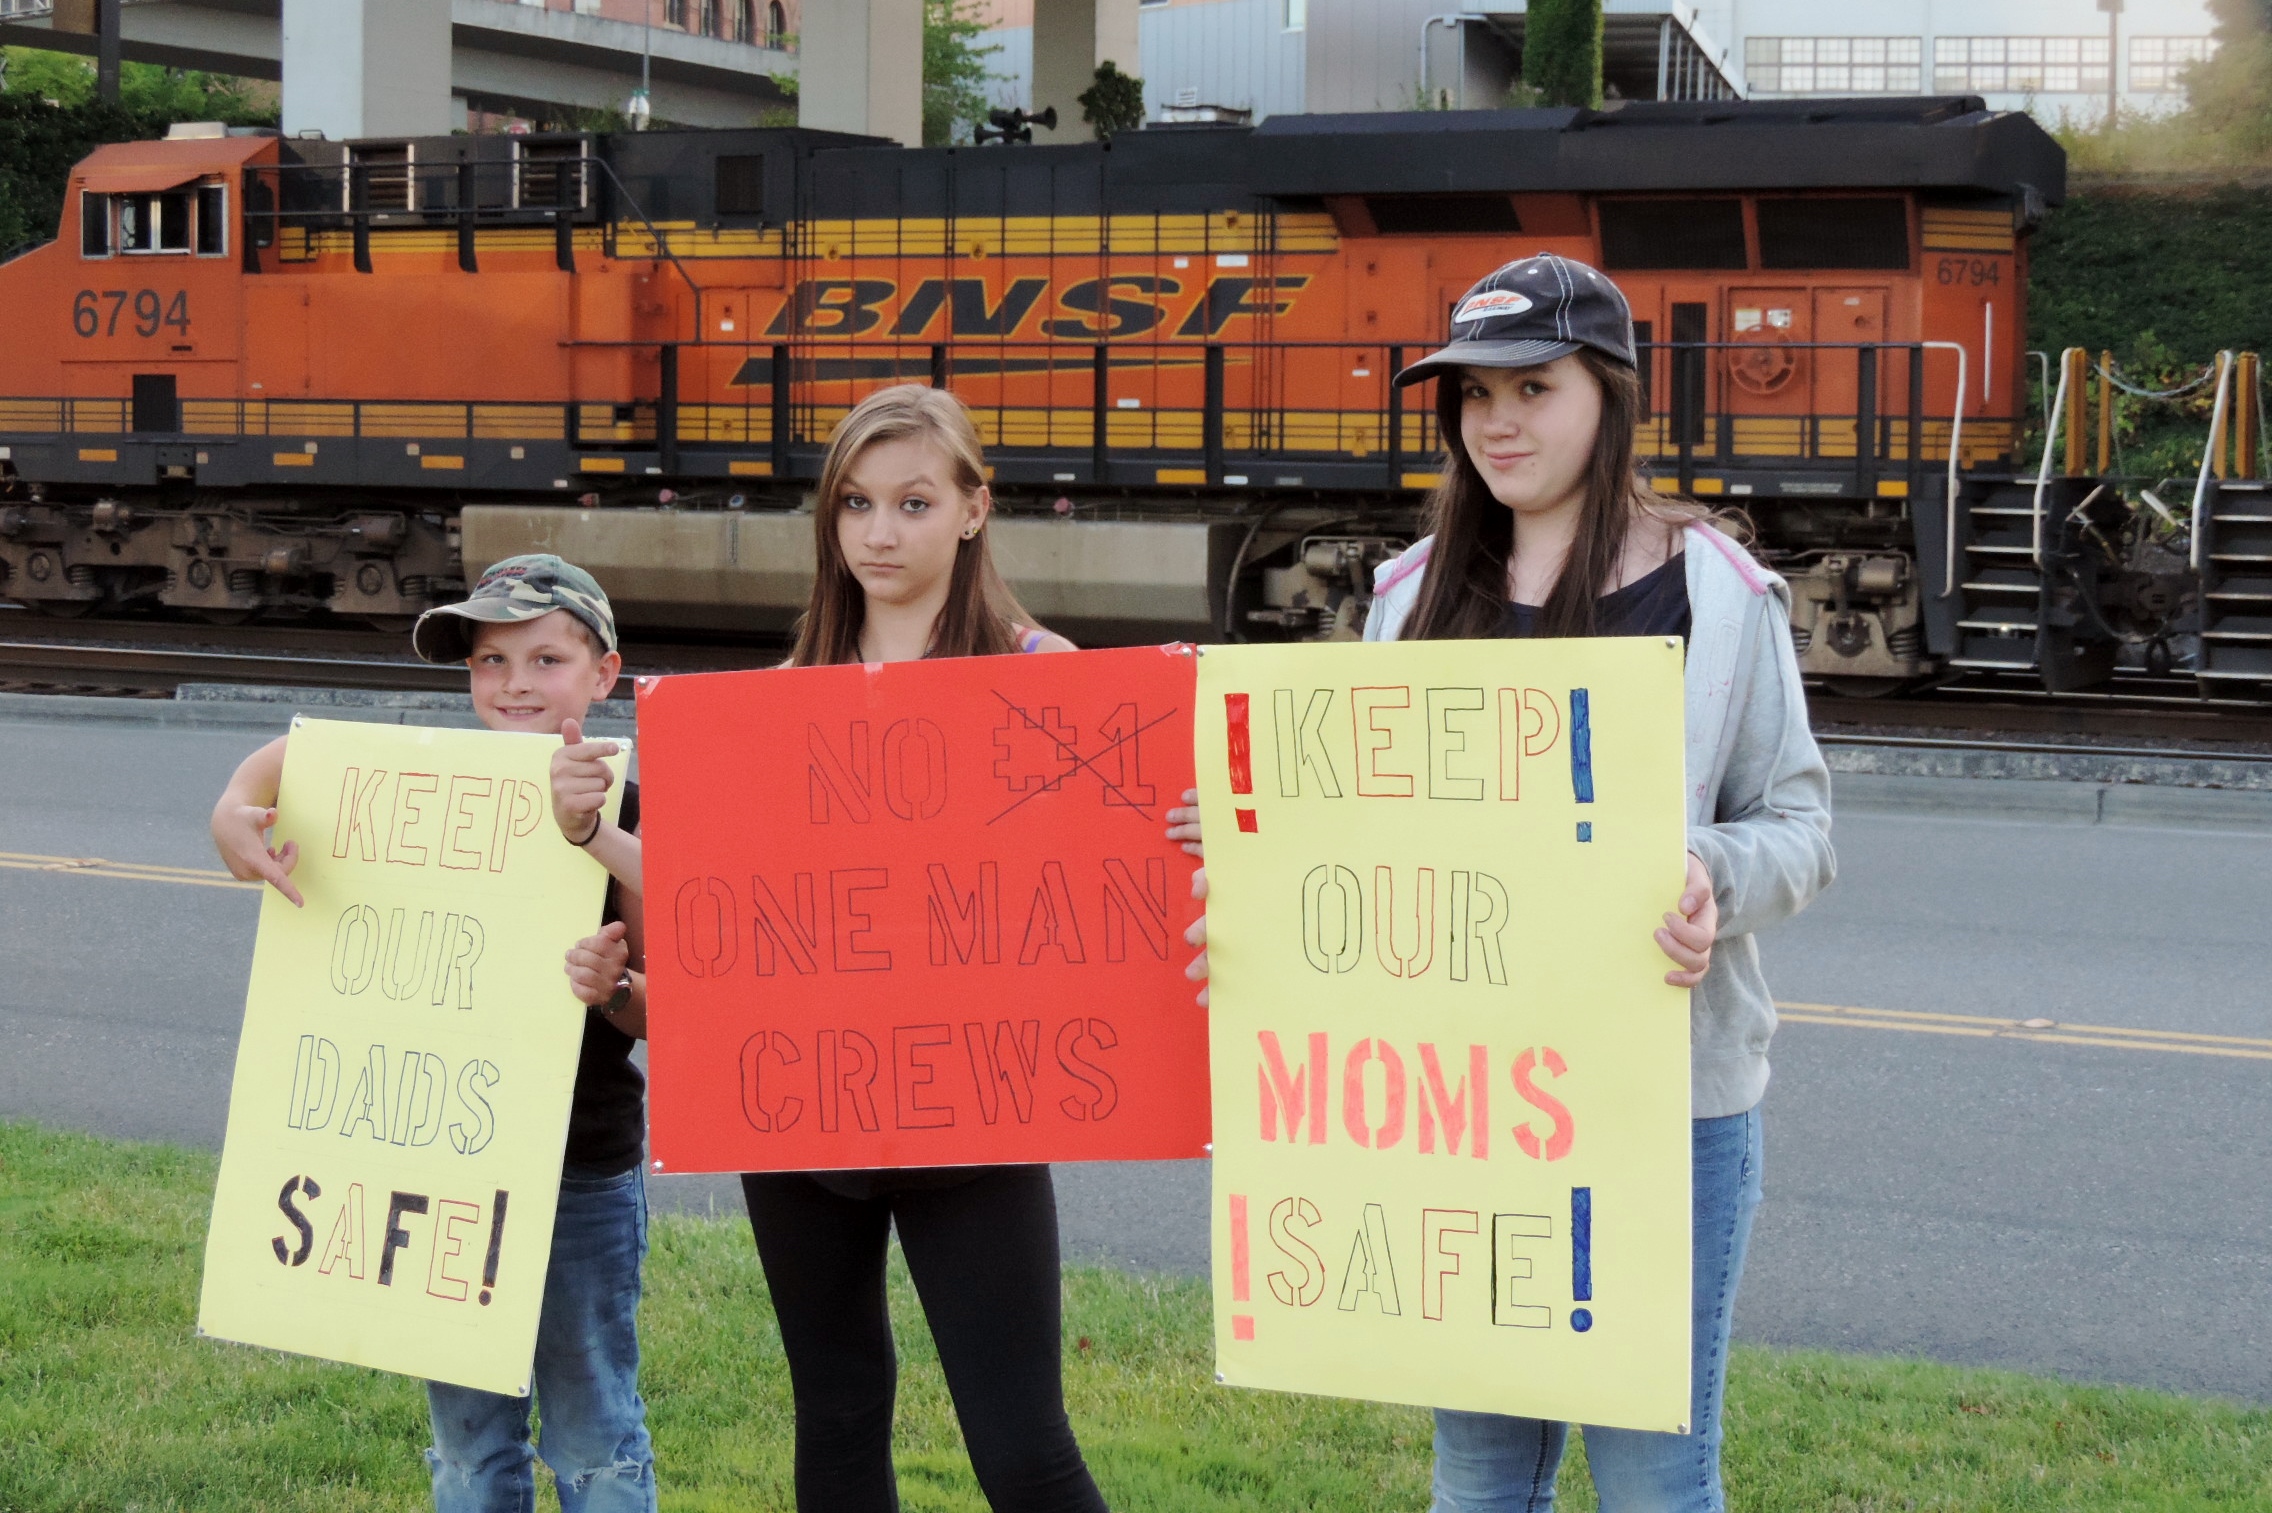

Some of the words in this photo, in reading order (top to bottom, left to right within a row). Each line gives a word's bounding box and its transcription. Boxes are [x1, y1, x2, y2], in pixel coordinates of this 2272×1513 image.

[73, 289, 191, 338] 6794
[759, 275, 1314, 341] BNSF
[1937, 258, 2000, 286] 6794
[332, 767, 543, 873] KEEP
[807, 718, 948, 825] NO
[992, 702, 1157, 807] #1
[329, 903, 486, 1010] OUR
[674, 867, 892, 978] ONE
[927, 857, 1169, 966] MAN
[1301, 864, 1510, 986] OUR
[287, 1034, 501, 1155] DADS
[739, 1018, 1119, 1133] CREWS
[1256, 1030, 1575, 1161] MOMS
[270, 1174, 510, 1307] SAFE!
